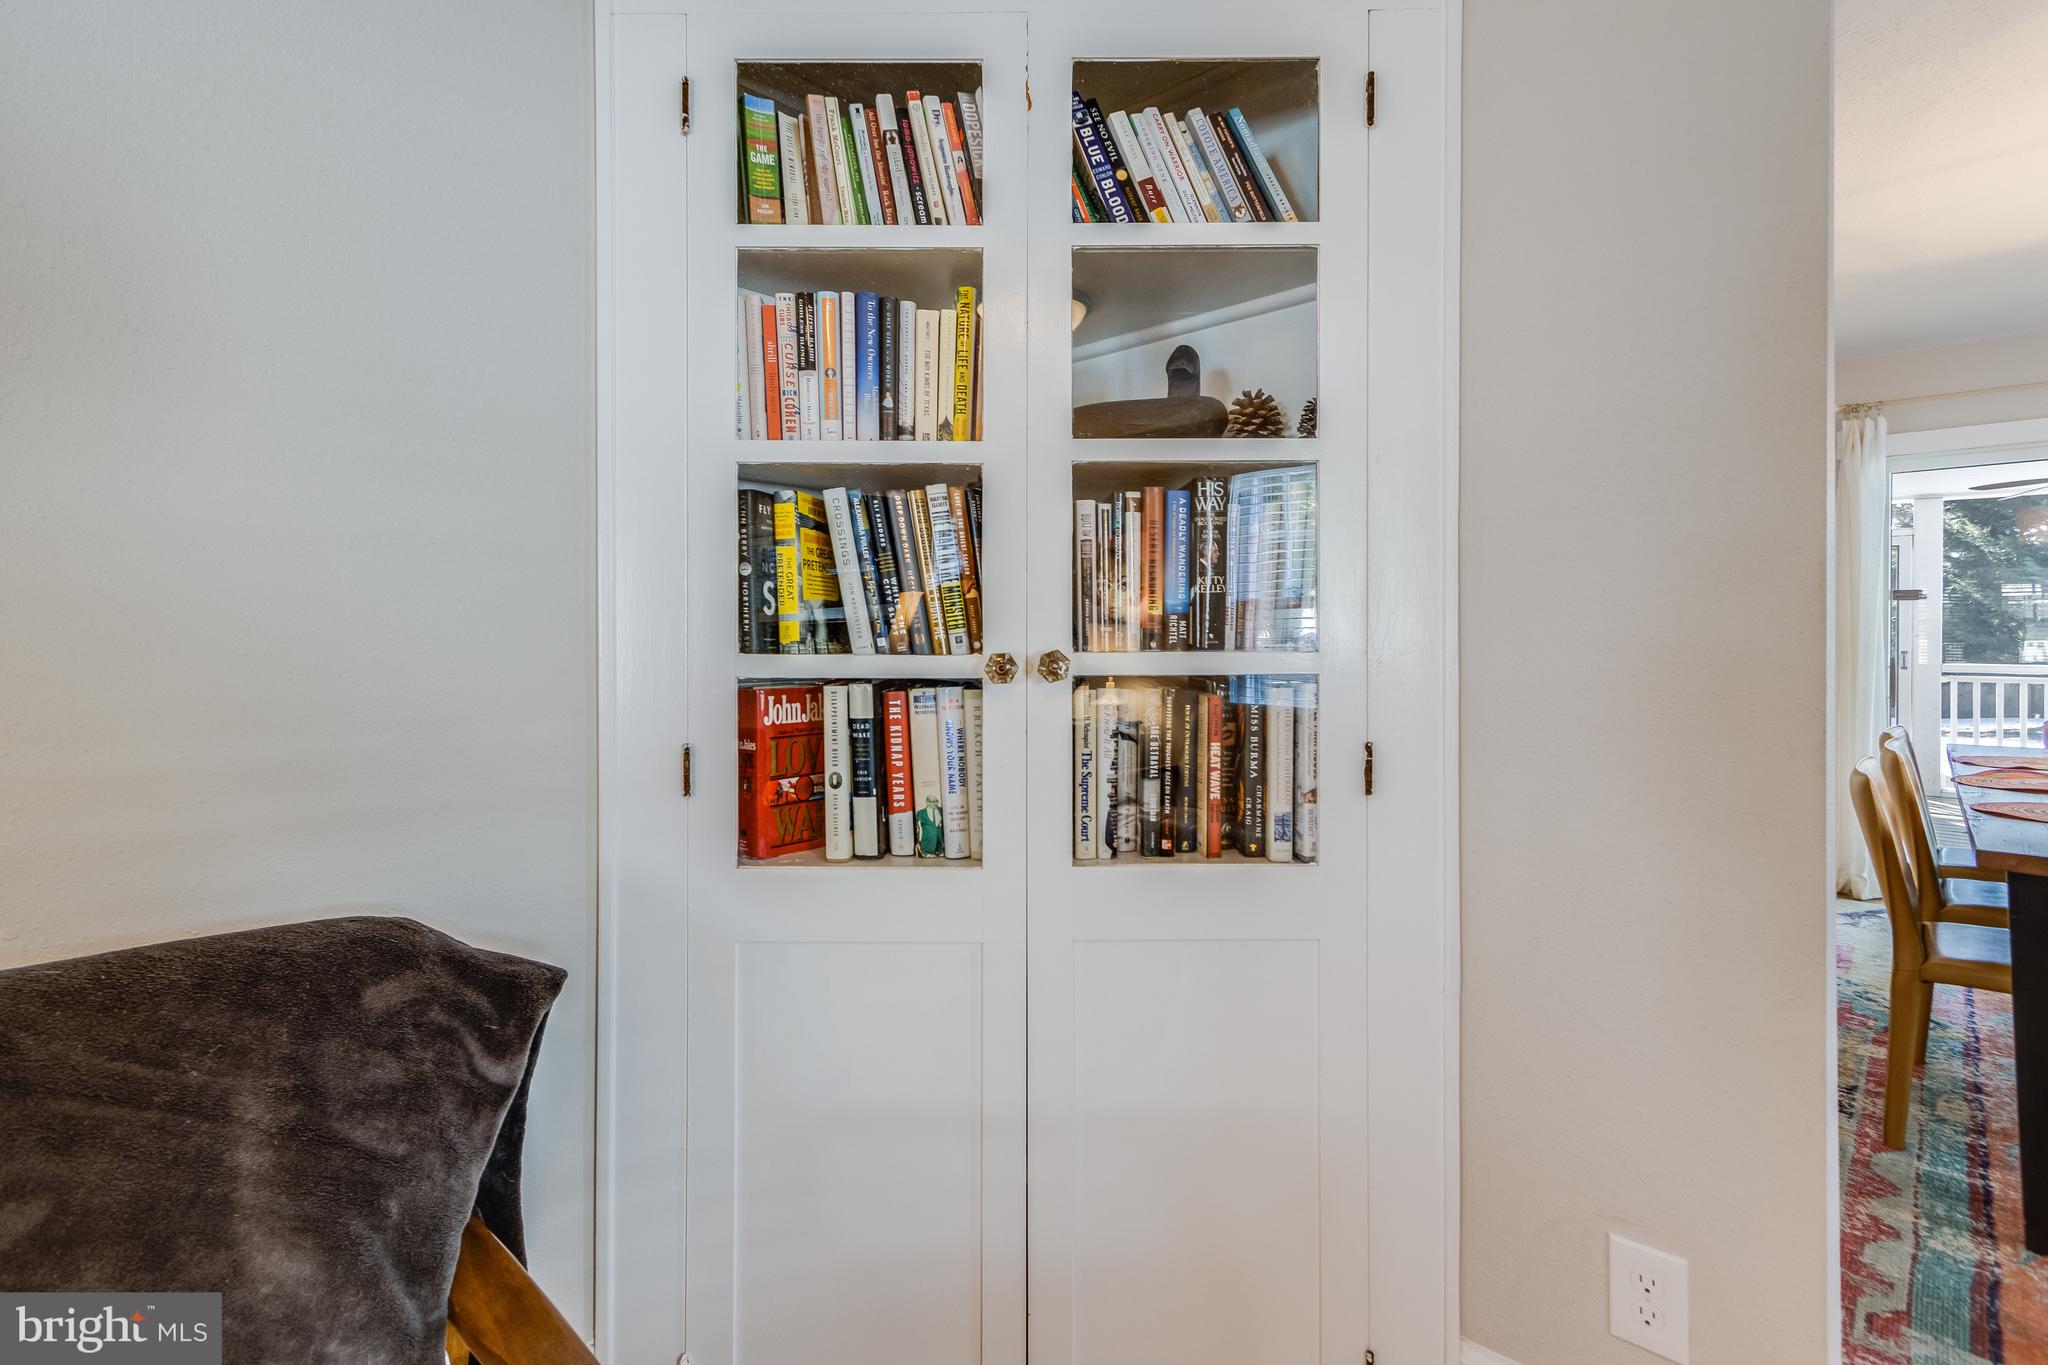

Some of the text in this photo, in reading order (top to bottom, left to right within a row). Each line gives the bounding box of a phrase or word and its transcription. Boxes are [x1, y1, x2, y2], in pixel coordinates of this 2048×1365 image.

[932, 109, 940, 127] Dry.
[1090, 108, 1101, 122] SEE
[1097, 124, 1107, 139] NO
[1105, 141, 1118, 162] EVIL
[756, 144, 767, 152] THE
[833, 135, 841, 165] McCourt
[1141, 128, 1167, 183] COOKING GENE
[1152, 113, 1184, 182] CARRY WARRIOR
[1236, 115, 1265, 168] Nomadland
[750, 153, 775, 165] GAME
[892, 152, 902, 173] naked
[1080, 127, 1105, 165] BLUE
[1101, 179, 1128, 223] BLOOD
[1196, 118, 1217, 156] COYOTE
[1211, 158, 1239, 203] AMERICA
[905, 144, 927, 223] janowitz scream
[1145, 184, 1158, 204] Burr
[1182, 190, 1192, 205] DOYLE
[1190, 194, 1201, 216] GLENNON
[867, 300, 875, 311] To
[958, 303, 970, 338] NATURE
[767, 341, 776, 363] shrill
[867, 329, 875, 346] New
[784, 343, 795, 388] CURSE
[867, 349, 875, 379] Owners
[958, 350, 968, 370] LIFE
[785, 397, 796, 432] COHEN
[957, 385, 967, 414] DEATH
[1195, 497, 1226, 511] WAY
[1197, 482, 1224, 497] HIS
[832, 498, 851, 566] CROSSINGS
[853, 498, 870, 558] ALEXANDRA FULLER
[875, 513, 886, 547] SANDERS
[895, 496, 910, 564] DEEP DOWN DARK
[915, 498, 927, 525] DAVID
[934, 626, 944, 640] ME
[958, 530, 966, 551] DRIEST
[962, 553, 970, 575] SEASON
[786, 572, 794, 600] GREAT
[932, 510, 965, 631] THE MAN IN THE MONSTER
[1178, 545, 1186, 599] WANDERING
[883, 579, 891, 601] CITY
[890, 577, 906, 635] WHILE THE
[1169, 615, 1177, 644] RICHTEL
[764, 696, 801, 726] John
[889, 700, 902, 720] THE
[890, 726, 903, 767] KIDNAP
[945, 720, 956, 794] KNOWS YOUR NAME
[1250, 706, 1258, 778] MISS BURMA
[1082, 751, 1092, 769] The
[1150, 741, 1159, 778] BETRAYAL
[1210, 742, 1221, 800] HEAT WAVE
[893, 773, 905, 807] YEARS
[1079, 772, 1092, 813] Supreme
[1081, 815, 1092, 841] Court
